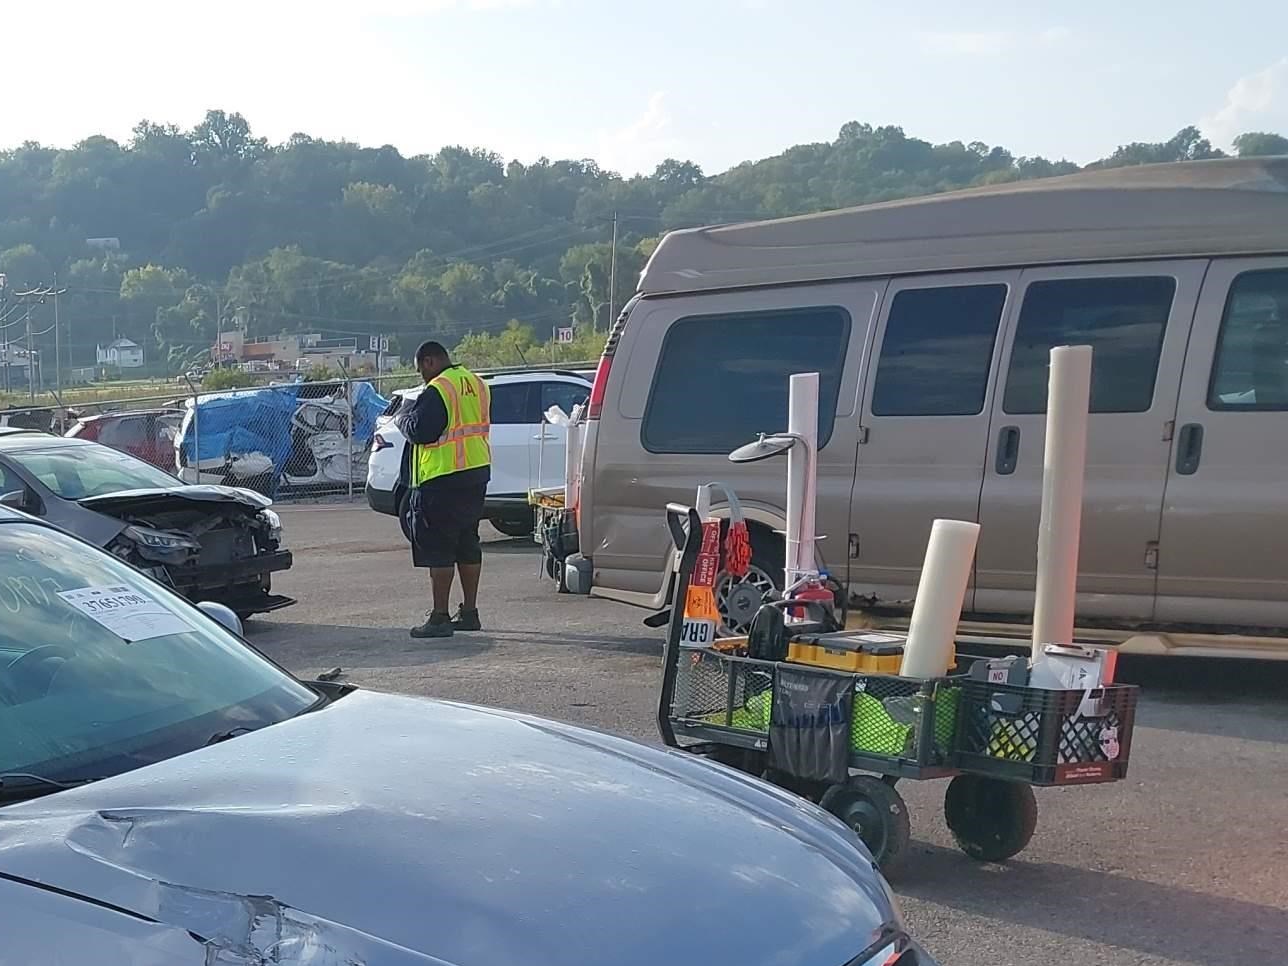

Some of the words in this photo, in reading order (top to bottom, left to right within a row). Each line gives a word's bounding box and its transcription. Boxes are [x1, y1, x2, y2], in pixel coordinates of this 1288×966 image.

[561, 331, 572, 341] 10
[700, 559, 709, 583] OFFICE
[82, 594, 146, 612] 37651790
[992, 671, 1004, 681] NO
